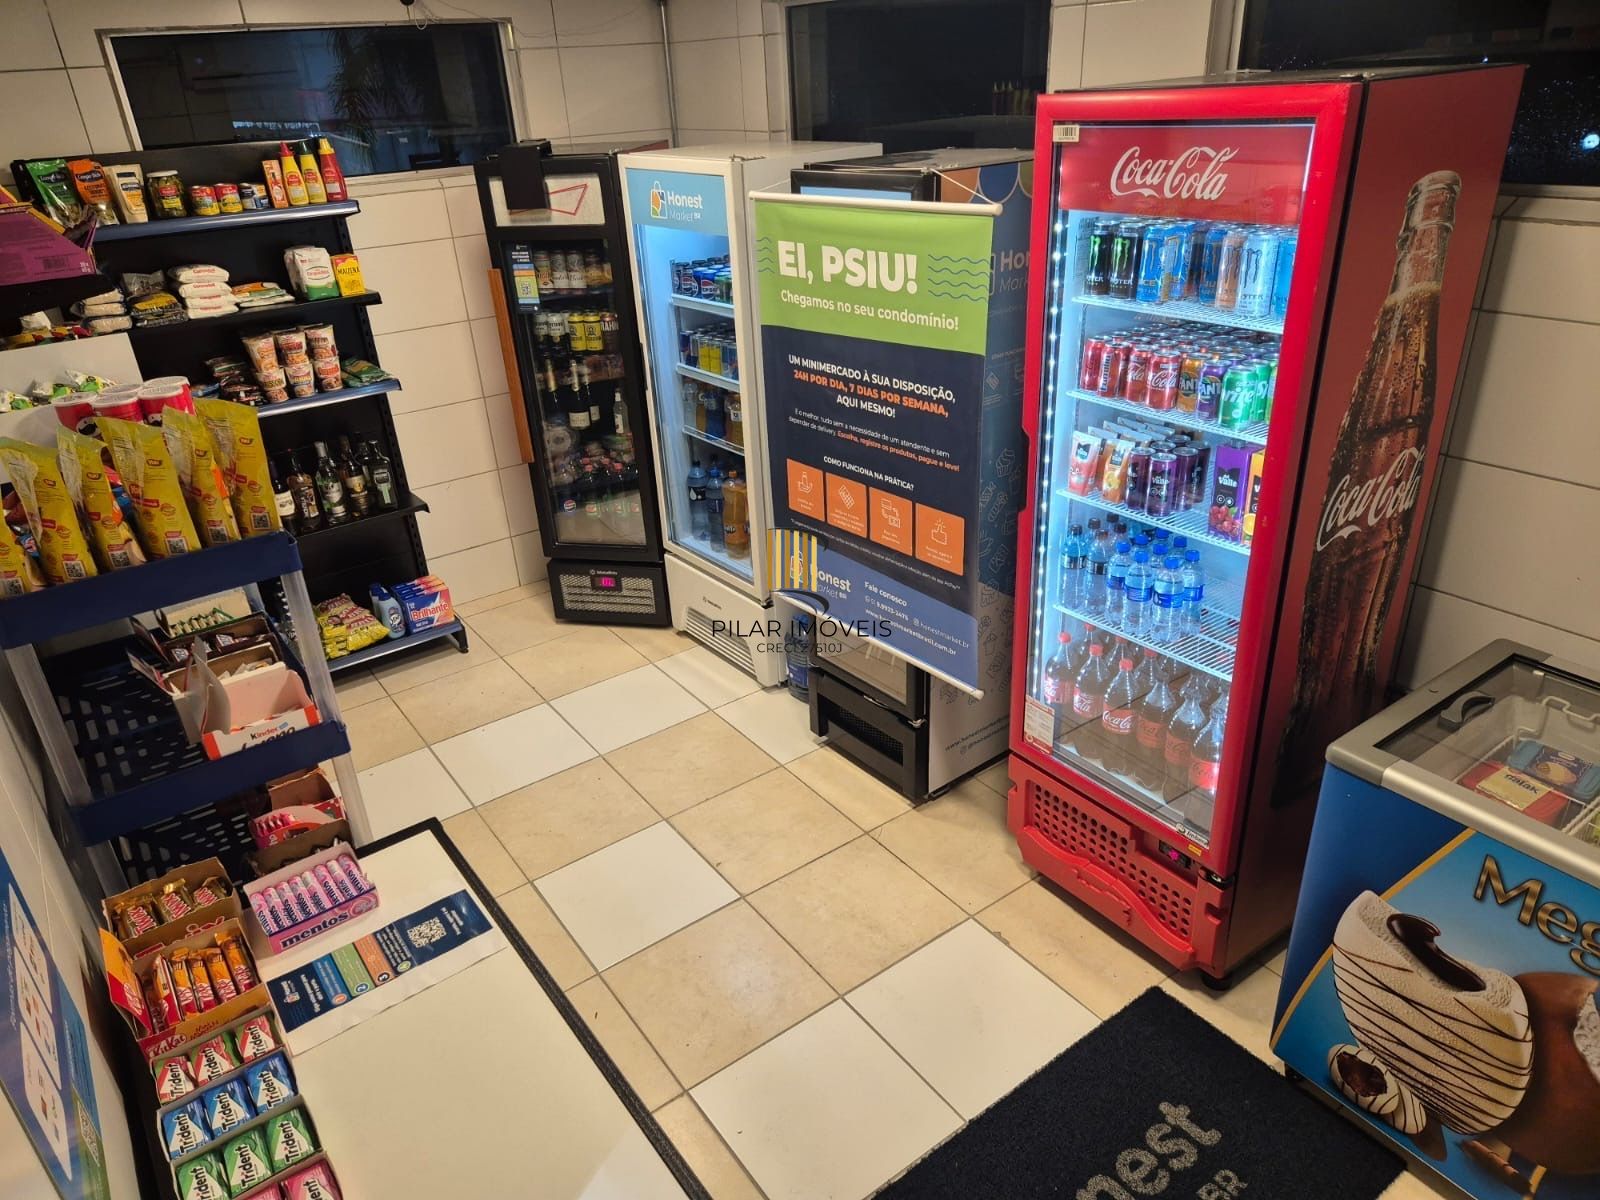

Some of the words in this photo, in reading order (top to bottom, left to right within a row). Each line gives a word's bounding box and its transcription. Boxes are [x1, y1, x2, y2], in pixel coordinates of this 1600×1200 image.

[1110, 146, 1240, 200] Coca-Cola
[667, 190, 703, 209] Honest
[777, 240, 813, 285] EI,
[821, 245, 918, 295] PSIU!
[781, 289, 834, 311] Chegamos
[837, 302, 851, 313] no
[854, 304, 875, 319] seu
[878, 308, 959, 331] condomínio!
[788, 354, 801, 367] UM
[801, 356, 862, 380] MINIMERCADO
[863, 369, 870, 382] À
[872, 374, 891, 387] SUA
[892, 378, 956, 403] DISPOSIÇÃO,
[793, 369, 809, 383] 24H
[810, 374, 828, 387] POR
[829, 379, 848, 394] DIA,
[849, 383, 855, 393] 7
[856, 385, 879, 400] DIAS
[880, 390, 901, 404] POR
[902, 396, 949, 418] SEMANA,
[836, 394, 858, 408] AQUI
[860, 400, 896, 418] MESMO!
[882, 433, 889, 441] de
[889, 436, 900, 445] um
[936, 448, 950, 458] sem
[823, 455, 842, 468] COMO
[842, 459, 874, 479] FUNCIONA
[874, 469, 884, 481] NA
[884, 471, 914, 491] PRÁTICA?
[1317, 447, 1425, 551] Coca-Cola
[811, 563, 851, 593] onest
[864, 581, 878, 594] Fale
[879, 589, 907, 607] conosco
[411, 601, 449, 621] Brilhante
[250, 727, 278, 741] kinder
[281, 912, 349, 948] mentos
[167, 1063, 184, 1097] Trident
[259, 1071, 282, 1109] Trident
[215, 1092, 235, 1132] Trident
[174, 1114, 192, 1154] Trident
[279, 1121, 300, 1163] Trident
[191, 1167, 212, 1200] rident
[236, 1144, 258, 1190] Trident
